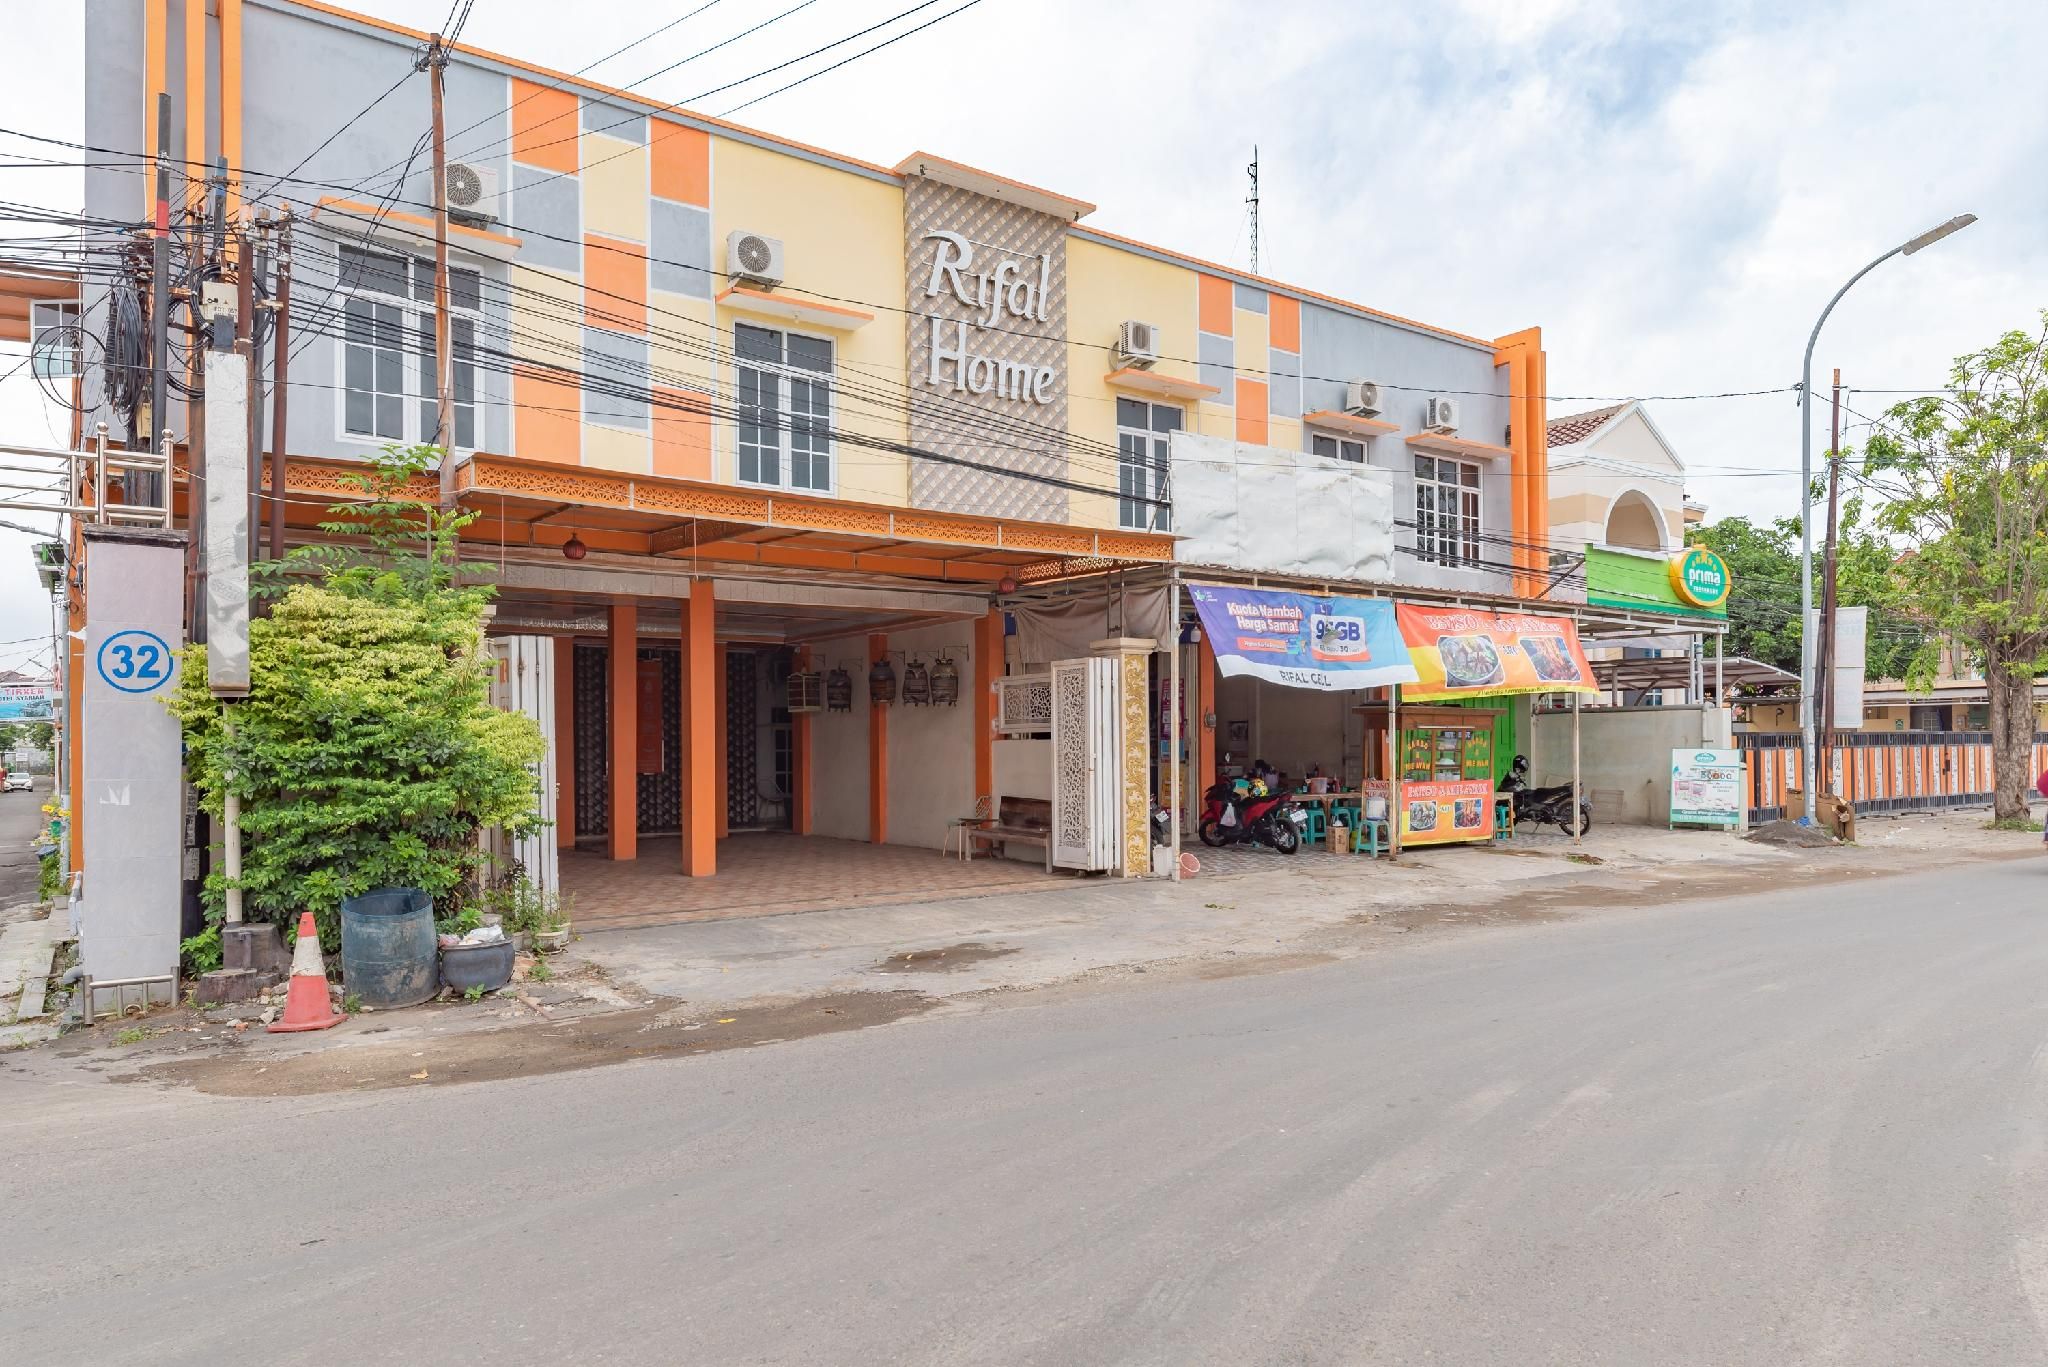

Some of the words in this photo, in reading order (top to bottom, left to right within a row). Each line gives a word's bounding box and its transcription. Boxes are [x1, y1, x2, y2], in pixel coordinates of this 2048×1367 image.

[923, 230, 1051, 329] Rifal
[927, 313, 1055, 404] Home
[1688, 568, 1720, 586] prima
[1226, 602, 1260, 617] Kuota
[1259, 604, 1303, 618] Nambah
[1235, 616, 1267, 633] Harga
[1267, 619, 1299, 632] Sama!
[112, 645, 160, 678] 32
[1279, 670, 1309, 683] RIFAL
